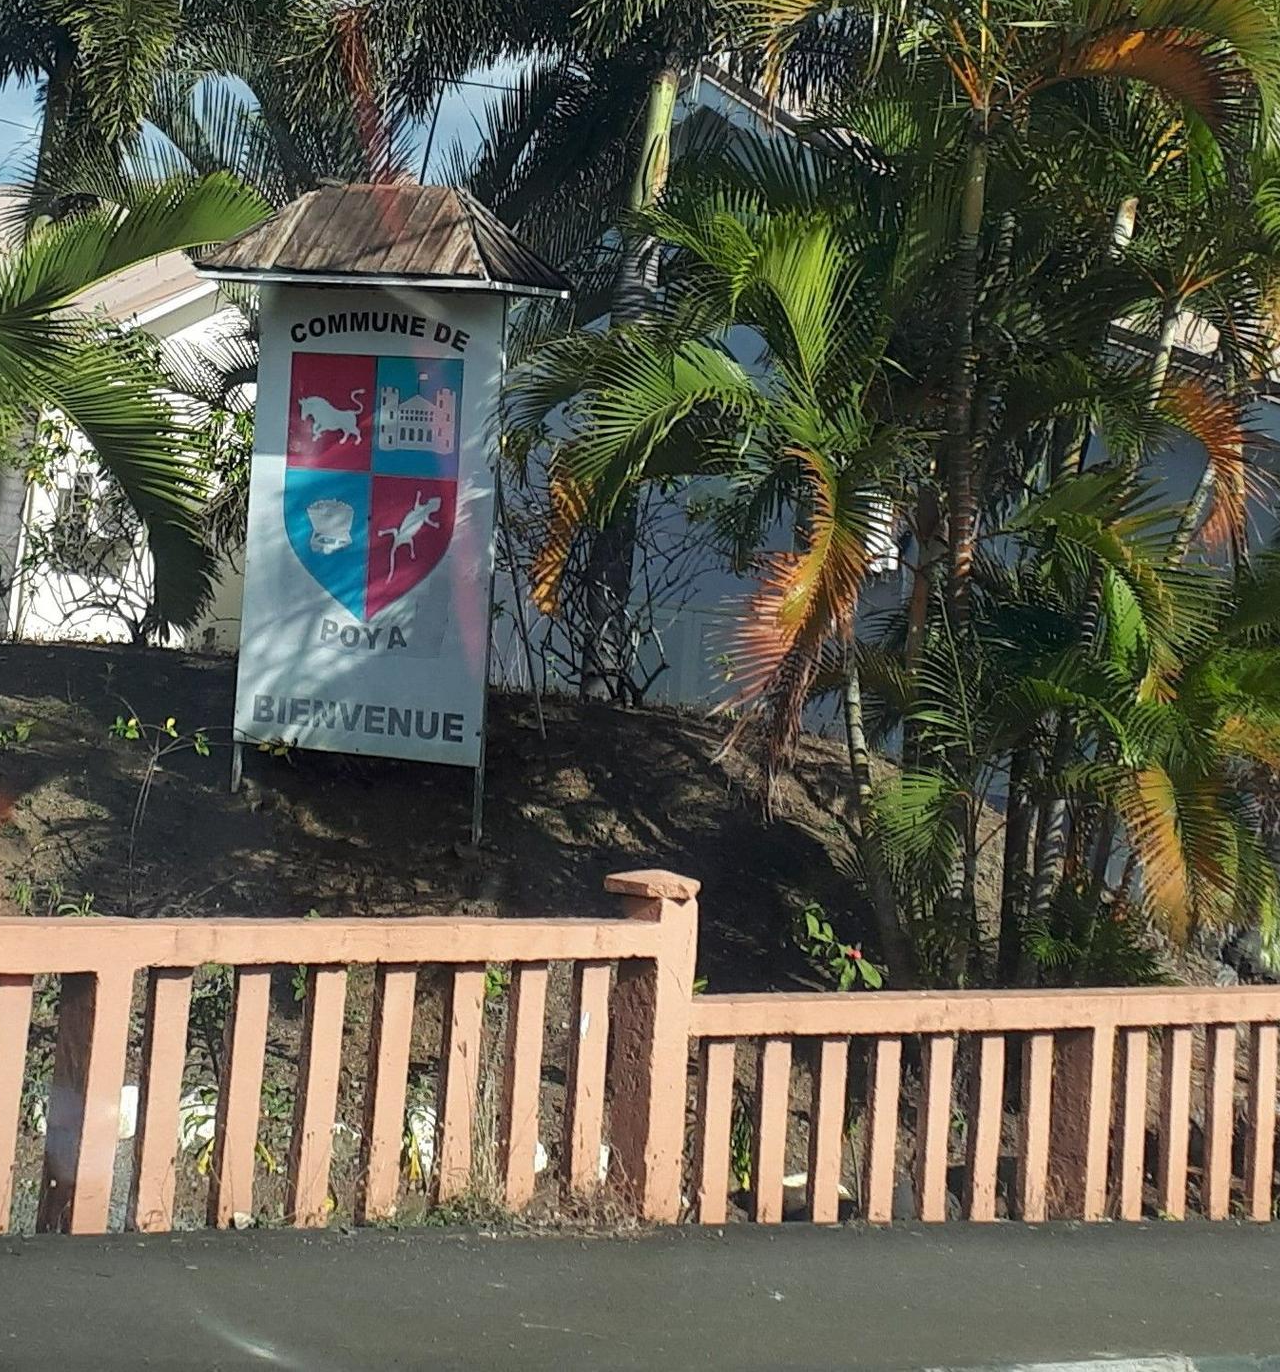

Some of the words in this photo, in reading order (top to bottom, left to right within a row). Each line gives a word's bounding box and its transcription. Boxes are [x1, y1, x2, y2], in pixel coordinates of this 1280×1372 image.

[290, 312, 427, 343] COMMUNE
[433, 322, 471, 352] DE
[320, 618, 407, 649] POYA
[252, 694, 465, 743] BIENVENUE
